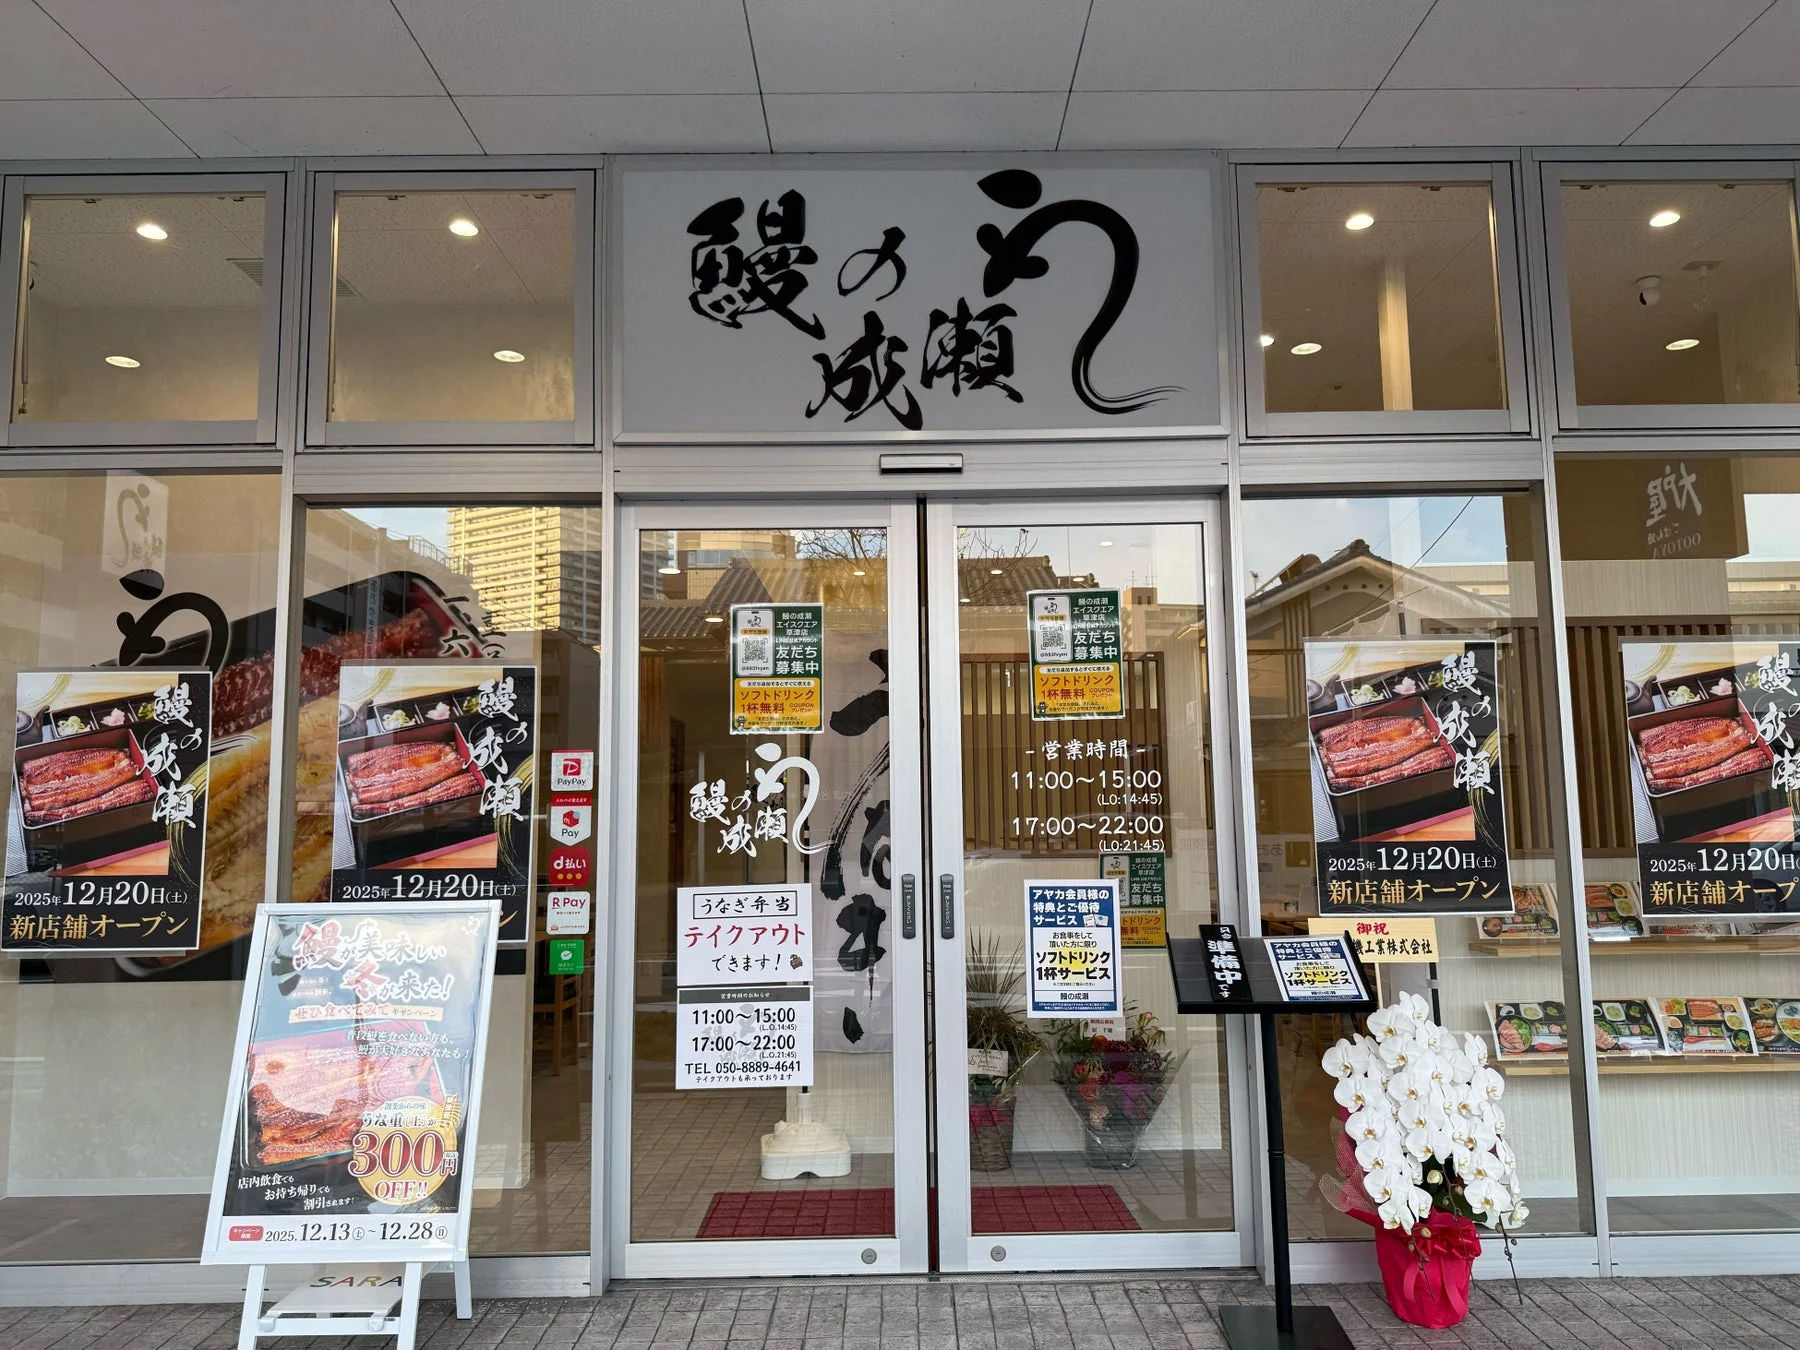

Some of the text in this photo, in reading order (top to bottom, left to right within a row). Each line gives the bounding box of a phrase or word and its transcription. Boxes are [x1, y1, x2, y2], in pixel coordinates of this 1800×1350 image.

[1073, 631, 1116, 644] 友だち
[776, 646, 817, 659] 友だち
[1073, 646, 1118, 660] 募集中
[776, 661, 819, 674] 募集中
[1040, 675, 1114, 686] ソフトドリンク
[740, 690, 815, 701] ソフトドリンク
[1041, 688, 1086, 700] 1杯無料
[740, 702, 785, 714] 1杯無料
[1041, 739, 1128, 760] 営業時間
[557, 778, 586, 786] PayPay
[562, 828, 579, 839] Pay
[553, 856, 586, 869] d払い
[1131, 883, 1162, 893] 友だち
[1327, 874, 1501, 904] 新店舗オープン
[1033, 889, 1109, 900] アヤカ会員様の
[1131, 895, 1164, 905] 募集中
[563, 897, 586, 909] Pay
[701, 896, 790, 915] うなぎ弁当
[1033, 902, 1100, 913] 特典とご優待
[9, 910, 191, 941] 新店舗オープン
[1034, 915, 1078, 926] サービス
[1356, 922, 1390, 936] 御祝
[684, 923, 805, 949] テイクアウト
[1052, 931, 1093, 940] お食事をして
[1049, 940, 1097, 949] 頂いた方に限り
[1036, 951, 1111, 964] ソフトドリンク
[1036, 966, 1111, 980] 1杯サービス
[1285, 970, 1348, 978] ソフトドリンク
[1287, 978, 1352, 986] 1杯サービス
[1060, 992, 1089, 1001] 鰻の成瀬
[685, 1060, 801, 1075] TEL 050-8889-4641
[238, 1173, 295, 1190] 店内飲食でも
[264, 1184, 331, 1201] お持ち帰りでも
